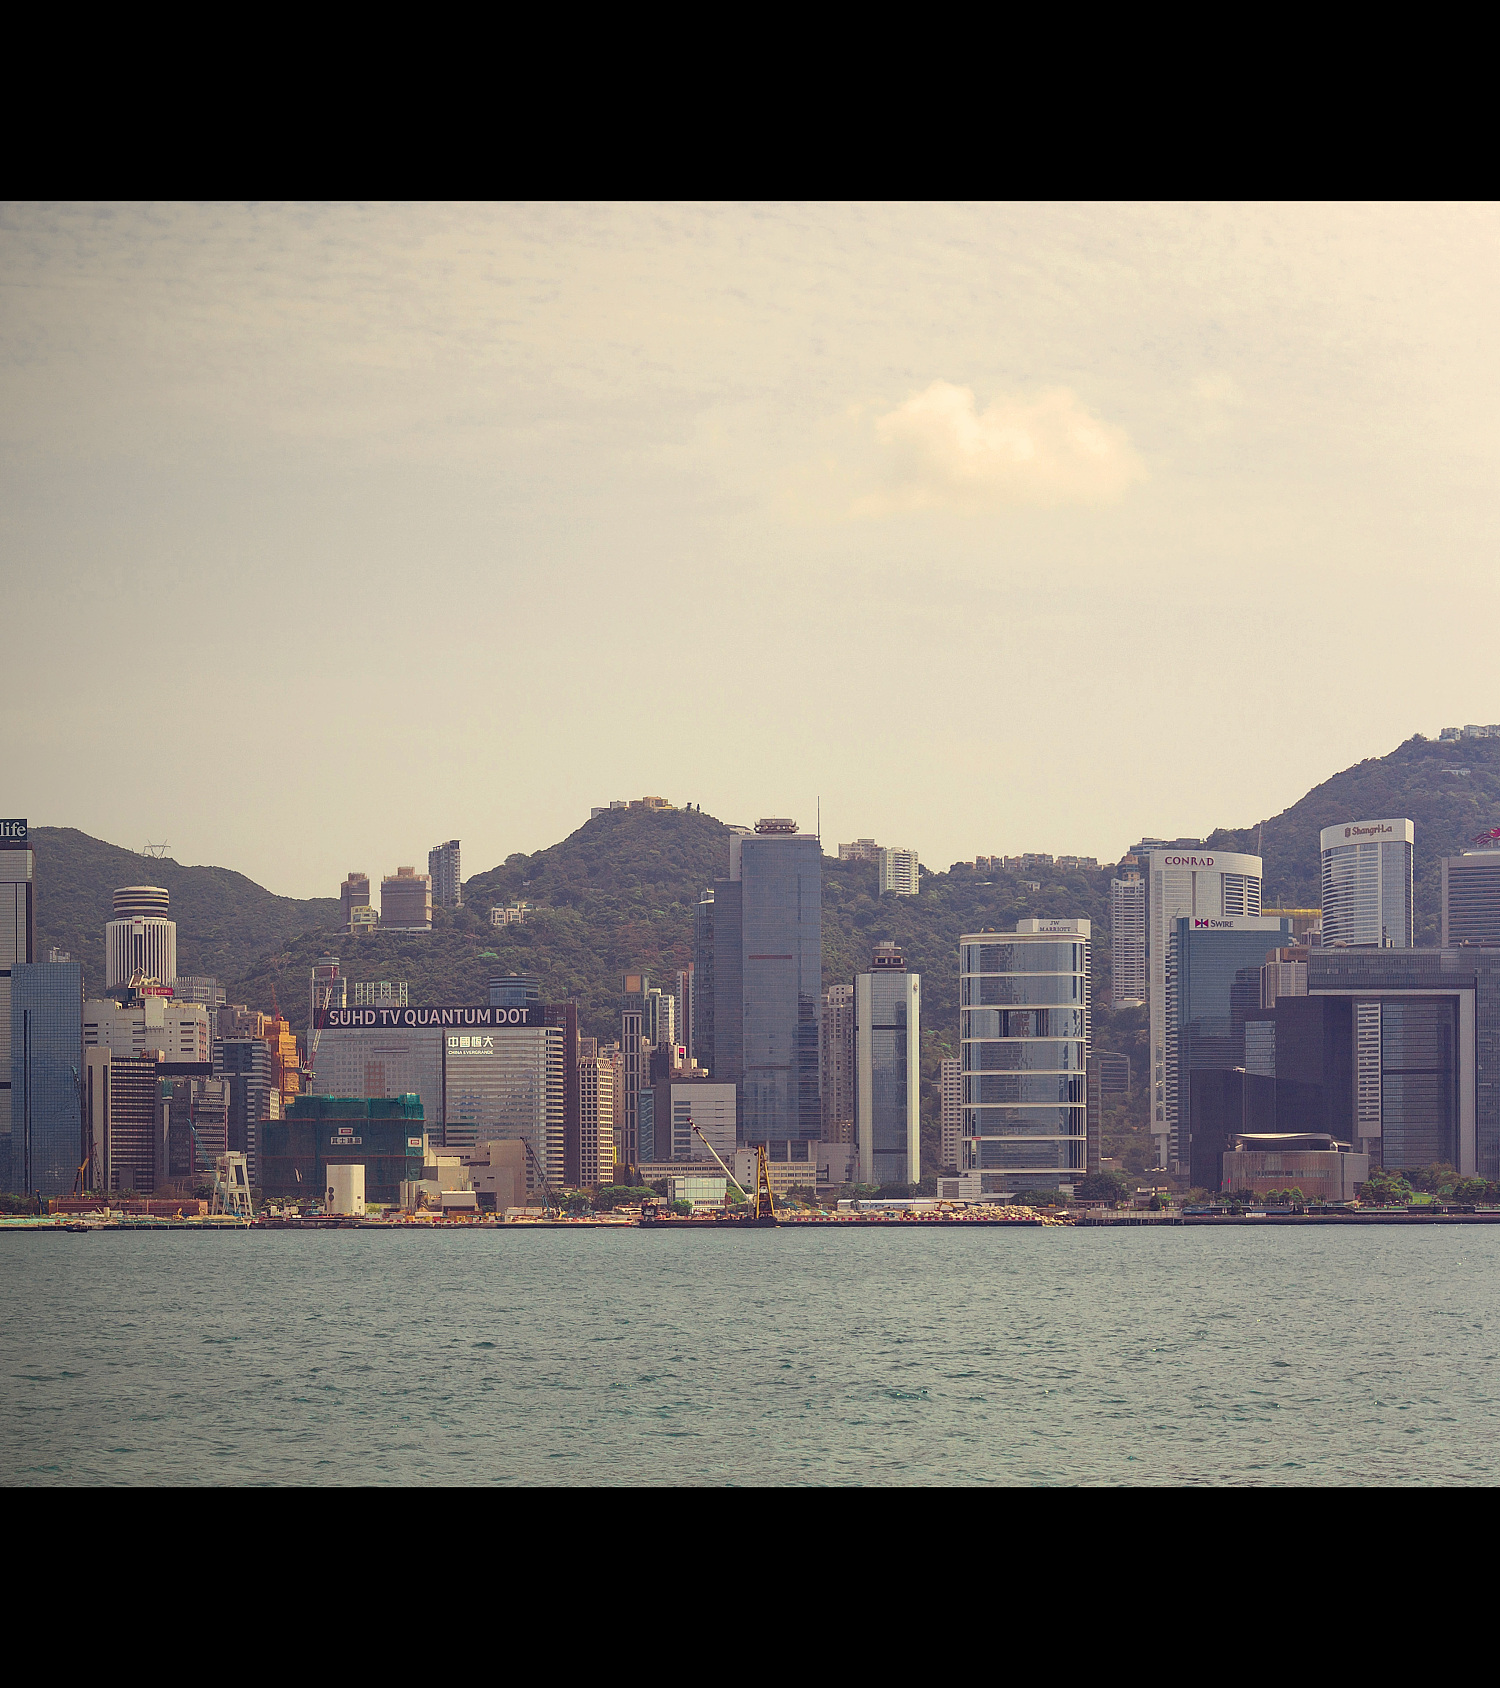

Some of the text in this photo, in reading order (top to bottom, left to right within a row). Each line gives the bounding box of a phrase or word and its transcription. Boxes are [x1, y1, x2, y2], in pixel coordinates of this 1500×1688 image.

[0, 821, 27, 837] life
[1351, 824, 1393, 836] Shangri-La
[1164, 856, 1215, 866] CONRAD
[329, 1008, 530, 1027] SUHD TV QUANTUM DOT
